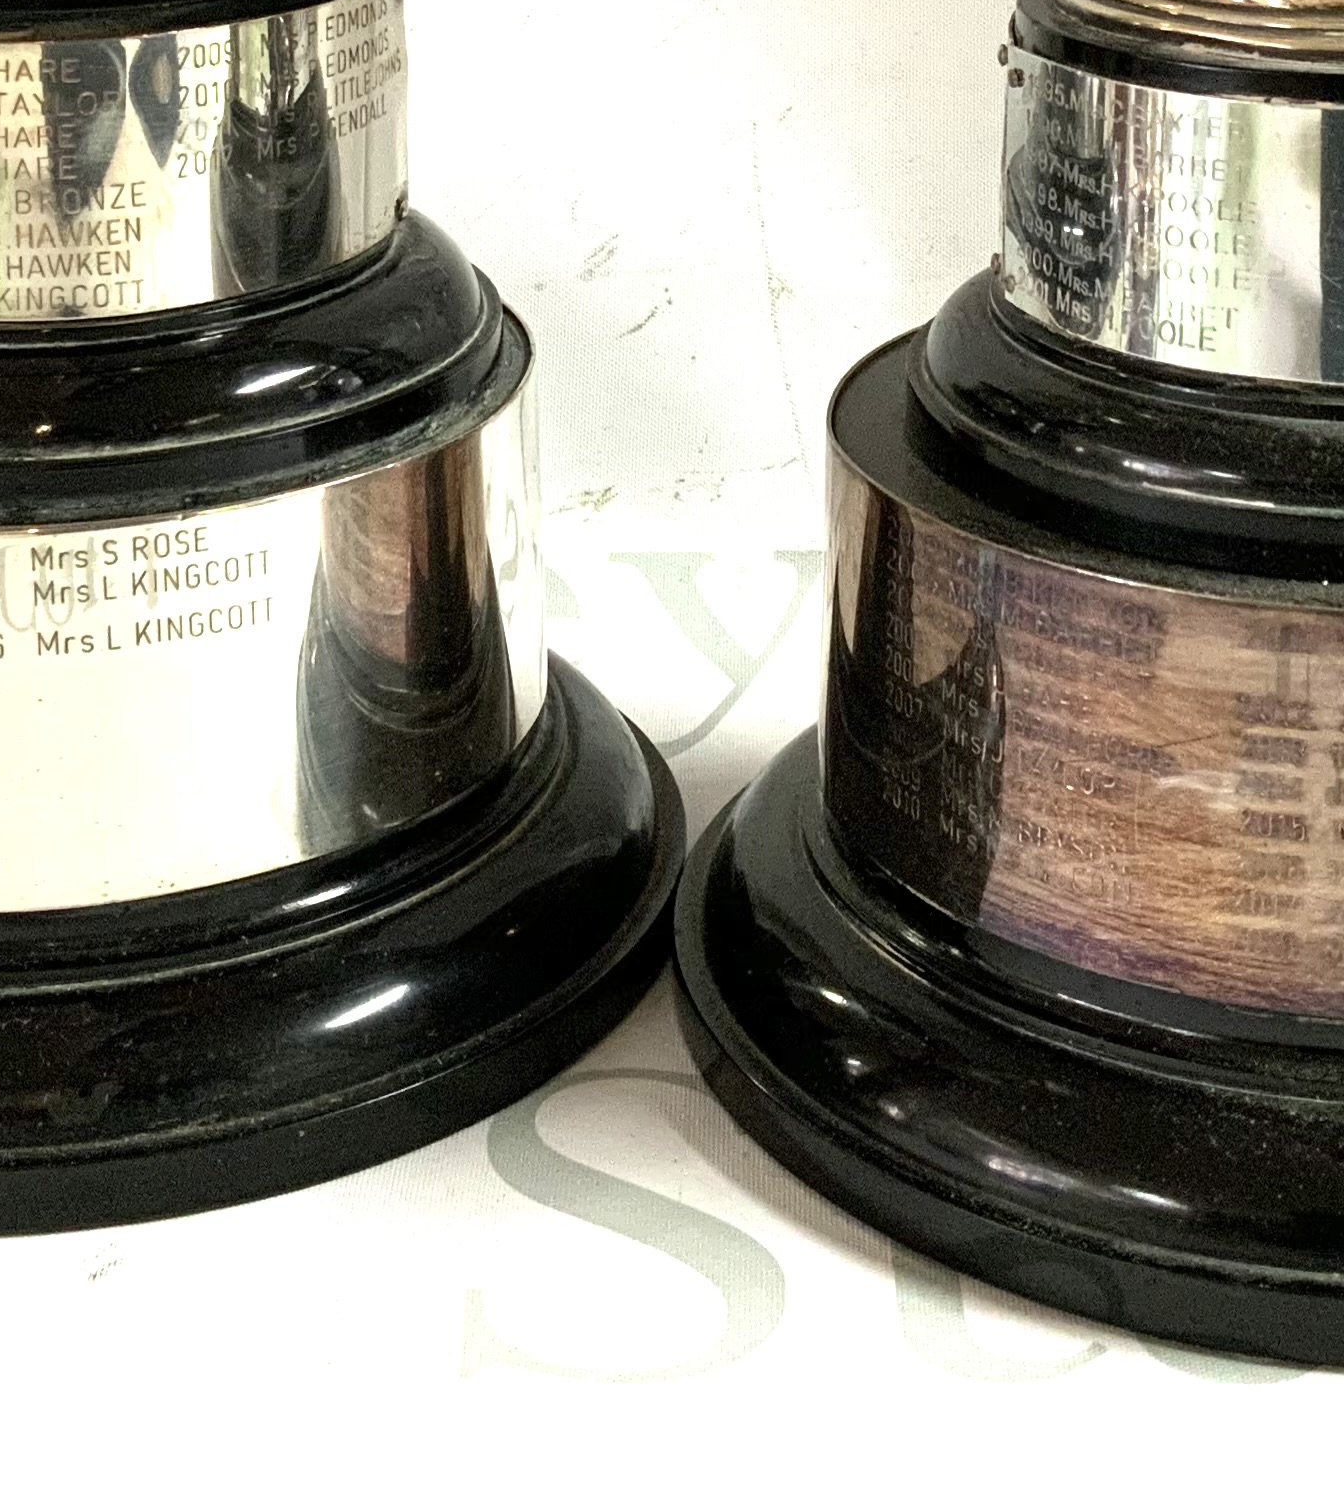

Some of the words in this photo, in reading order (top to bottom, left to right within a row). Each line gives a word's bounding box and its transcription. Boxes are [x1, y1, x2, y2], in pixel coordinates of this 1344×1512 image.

[257, 135, 297, 162] Mrs
[31, 545, 89, 572] Mrs
[102, 539, 119, 566] S
[132, 527, 209, 563] ROSE
[34, 580, 90, 607] Mrs
[103, 576, 117, 601] L
[132, 550, 269, 597] KINGCOTT
[37, 630, 95, 657] Mrs
[107, 626, 122, 651] L
[135, 597, 273, 646] KINGCOTT
